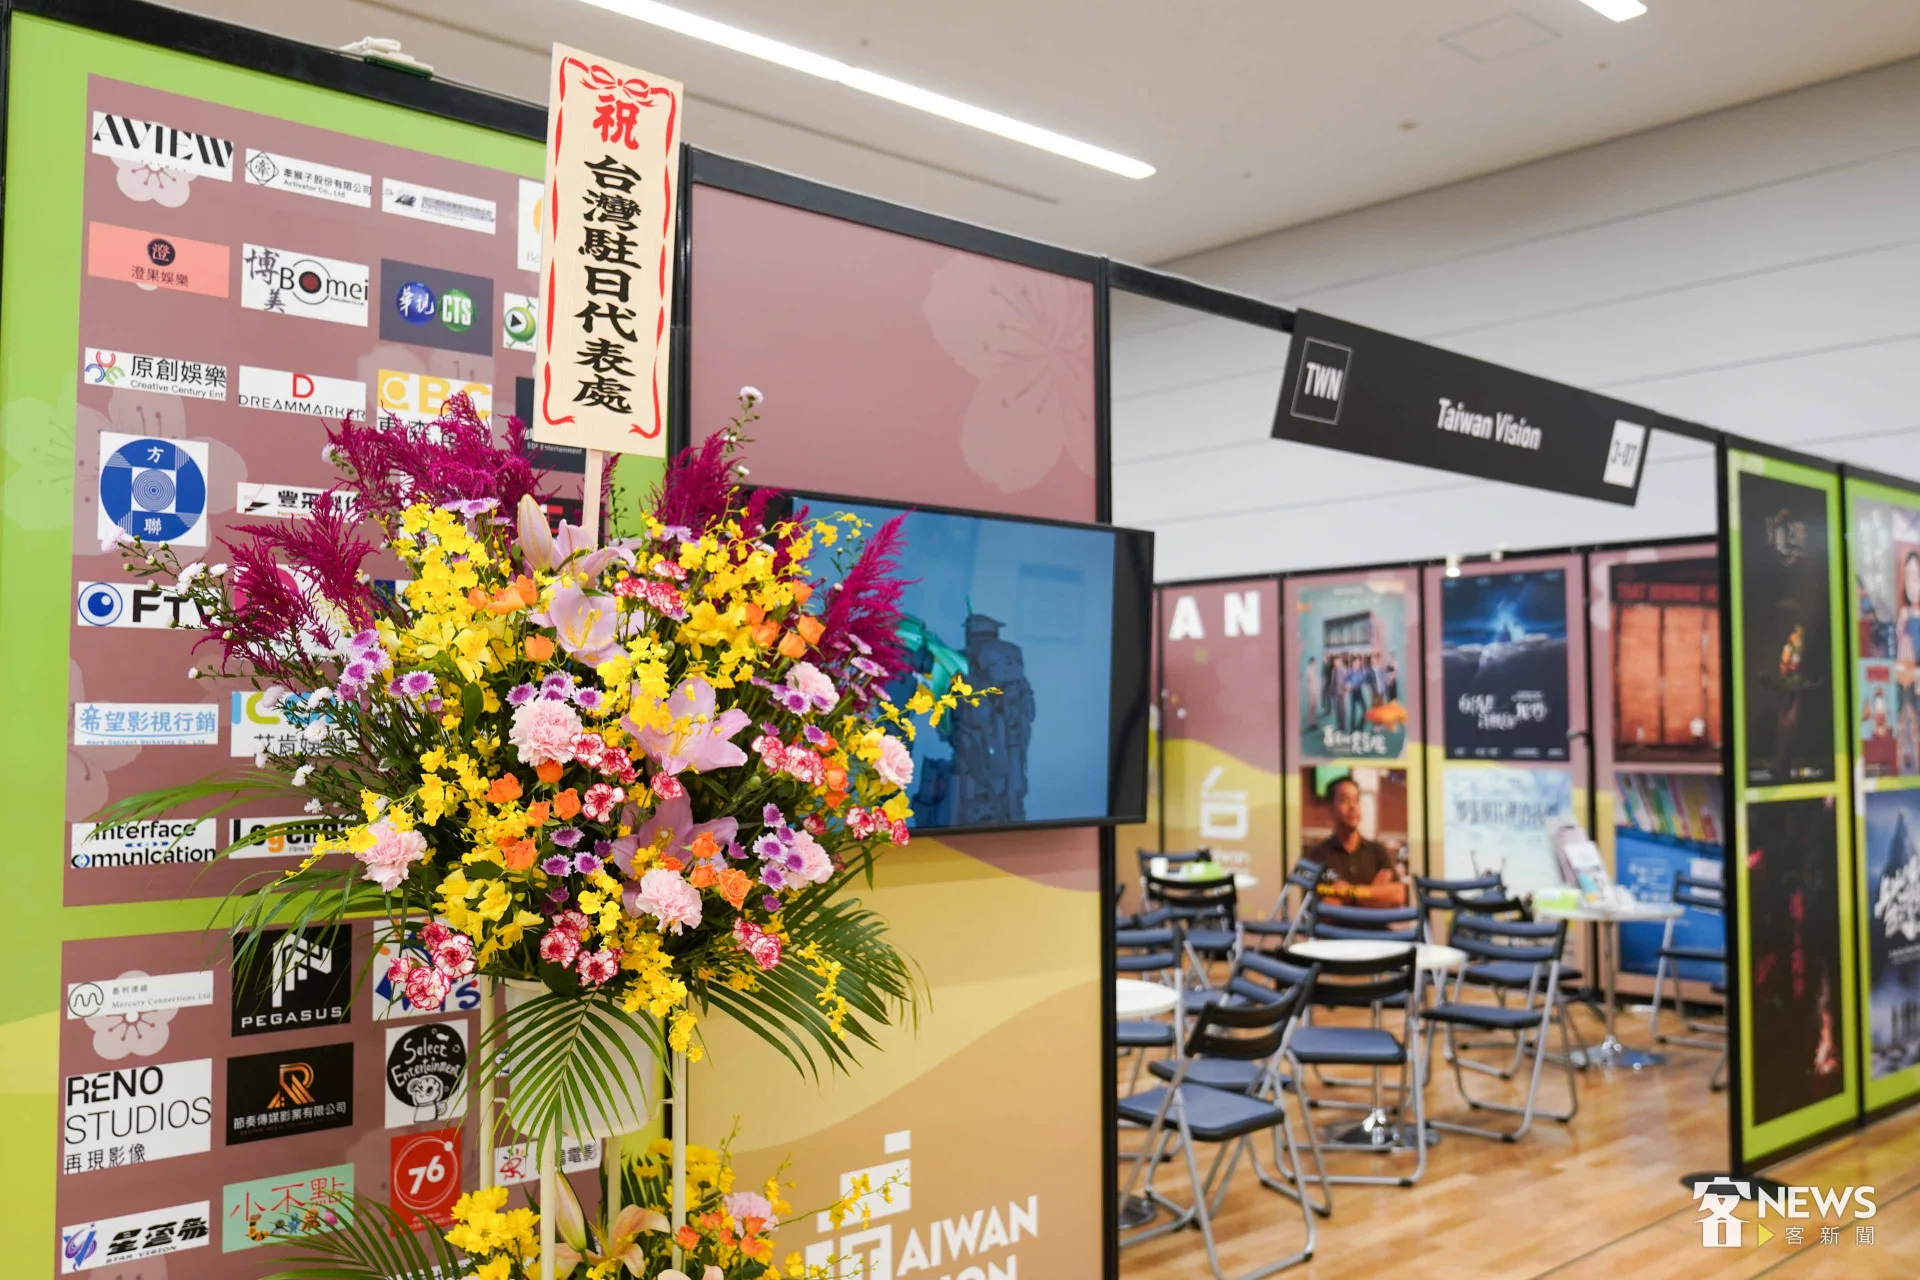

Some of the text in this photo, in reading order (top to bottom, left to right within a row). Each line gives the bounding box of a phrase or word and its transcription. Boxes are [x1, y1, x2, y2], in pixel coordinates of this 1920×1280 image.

[593, 94, 641, 150] 祝
[93, 113, 233, 168] AVIEW
[283, 180, 316, 193] Activator
[131, 265, 189, 288] 澄果娛樂
[572, 154, 643, 415] 台灣駐日代表處
[442, 294, 472, 326] CTS
[131, 355, 227, 389] 原創娛樂
[292, 373, 315, 399] D
[1303, 361, 1343, 401] TWN
[130, 380, 168, 392] Creative
[171, 385, 206, 398] Century
[1436, 397, 1543, 450] Taiwan Vision
[147, 446, 164, 464] 方
[143, 517, 163, 537] 聯
[79, 704, 217, 733] 希望影視行銷
[95, 820, 197, 841] Interface
[111, 1000, 146, 1009] Mercury
[147, 995, 197, 1005] Connections
[240, 1006, 343, 1029] PEGASUS
[403, 1037, 449, 1065] Select
[67, 1065, 164, 1107] RENO
[390, 1056, 462, 1088] Entertainment
[64, 1096, 212, 1145] STUDIOS
[233, 1101, 347, 1130] 節奏傳媒影業有限公司
[64, 1143, 146, 1175] 再現影像
[408, 1155, 445, 1195] 76
[229, 1176, 345, 1222] 小不點
